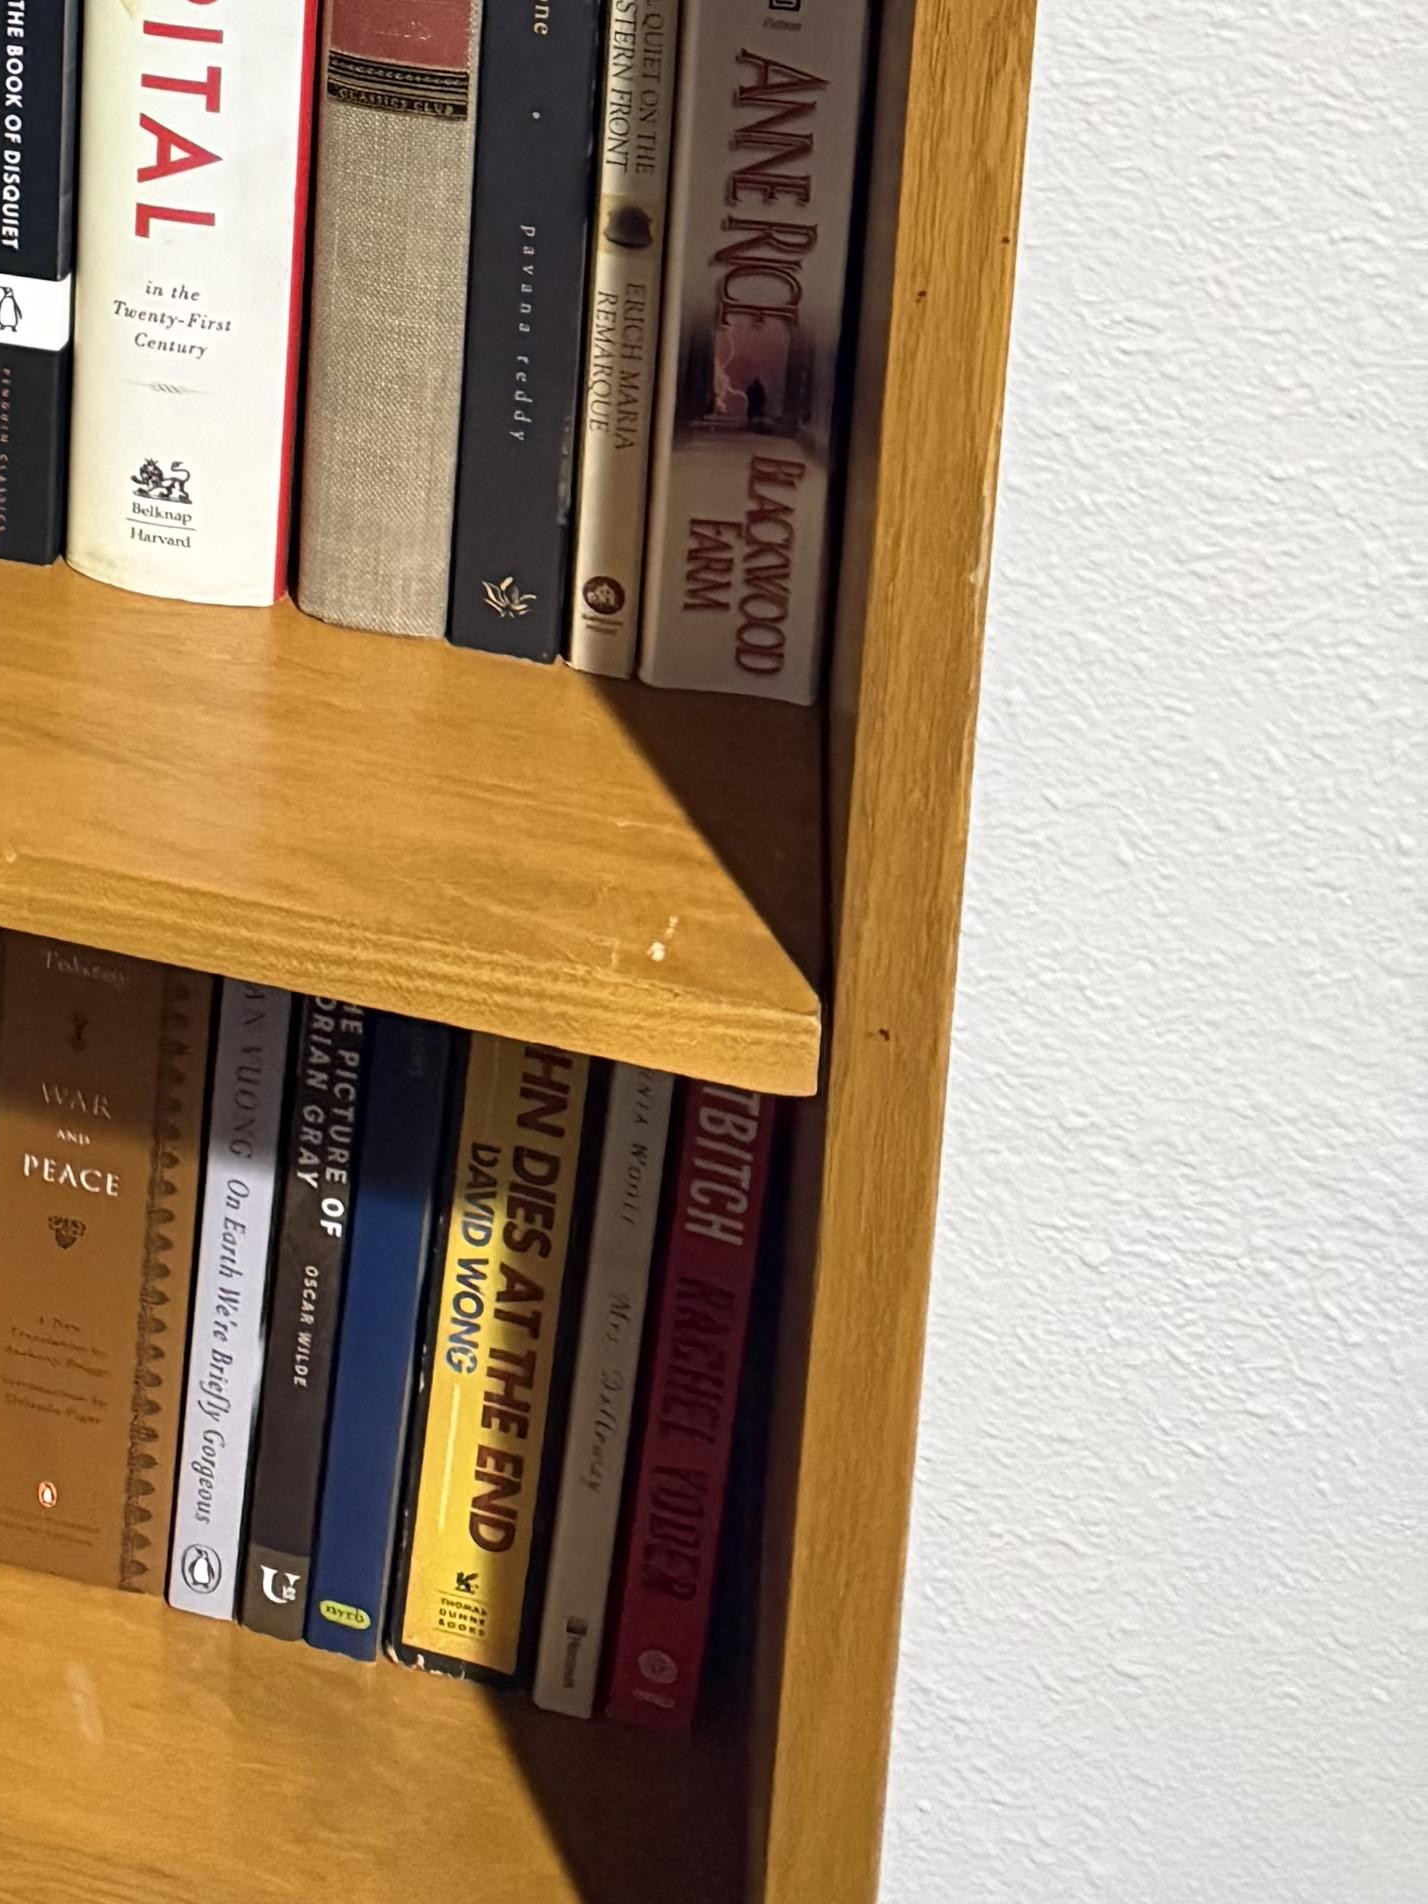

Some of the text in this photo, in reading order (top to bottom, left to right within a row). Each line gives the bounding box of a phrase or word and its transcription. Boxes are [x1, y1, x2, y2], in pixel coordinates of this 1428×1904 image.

[145, 279, 202, 302] in the
[112, 299, 233, 333] Twenty-First
[133, 332, 208, 360] Century
[131, 500, 193, 525] Belknap
[130, 526, 192, 549] Harvard
[22, 1152, 122, 1197] PEACE
[443, 1139, 504, 1378] DAVID WONG
